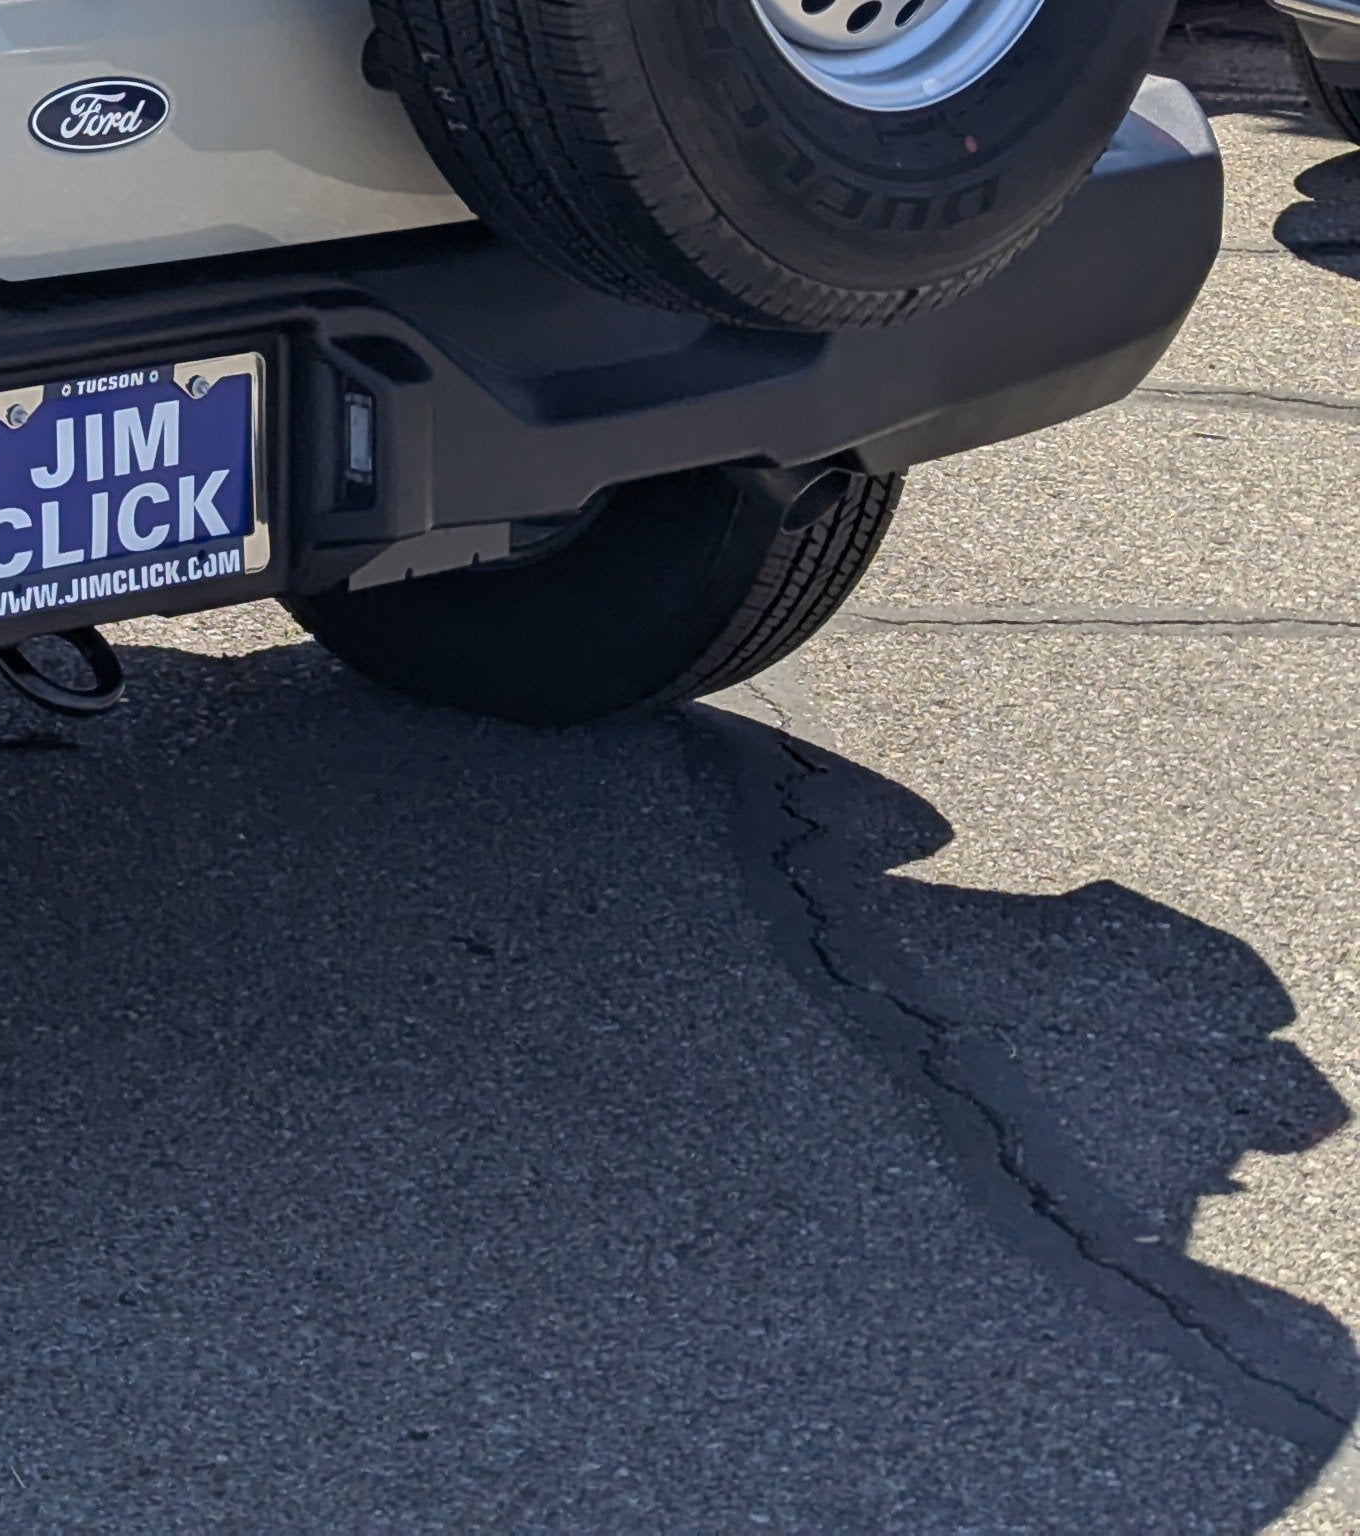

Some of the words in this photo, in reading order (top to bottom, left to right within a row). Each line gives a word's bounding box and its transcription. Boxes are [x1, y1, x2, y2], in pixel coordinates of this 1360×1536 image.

[60, 91, 146, 139] Ford
[76, 372, 145, 395] TUCSON
[30, 399, 180, 490] JIM
